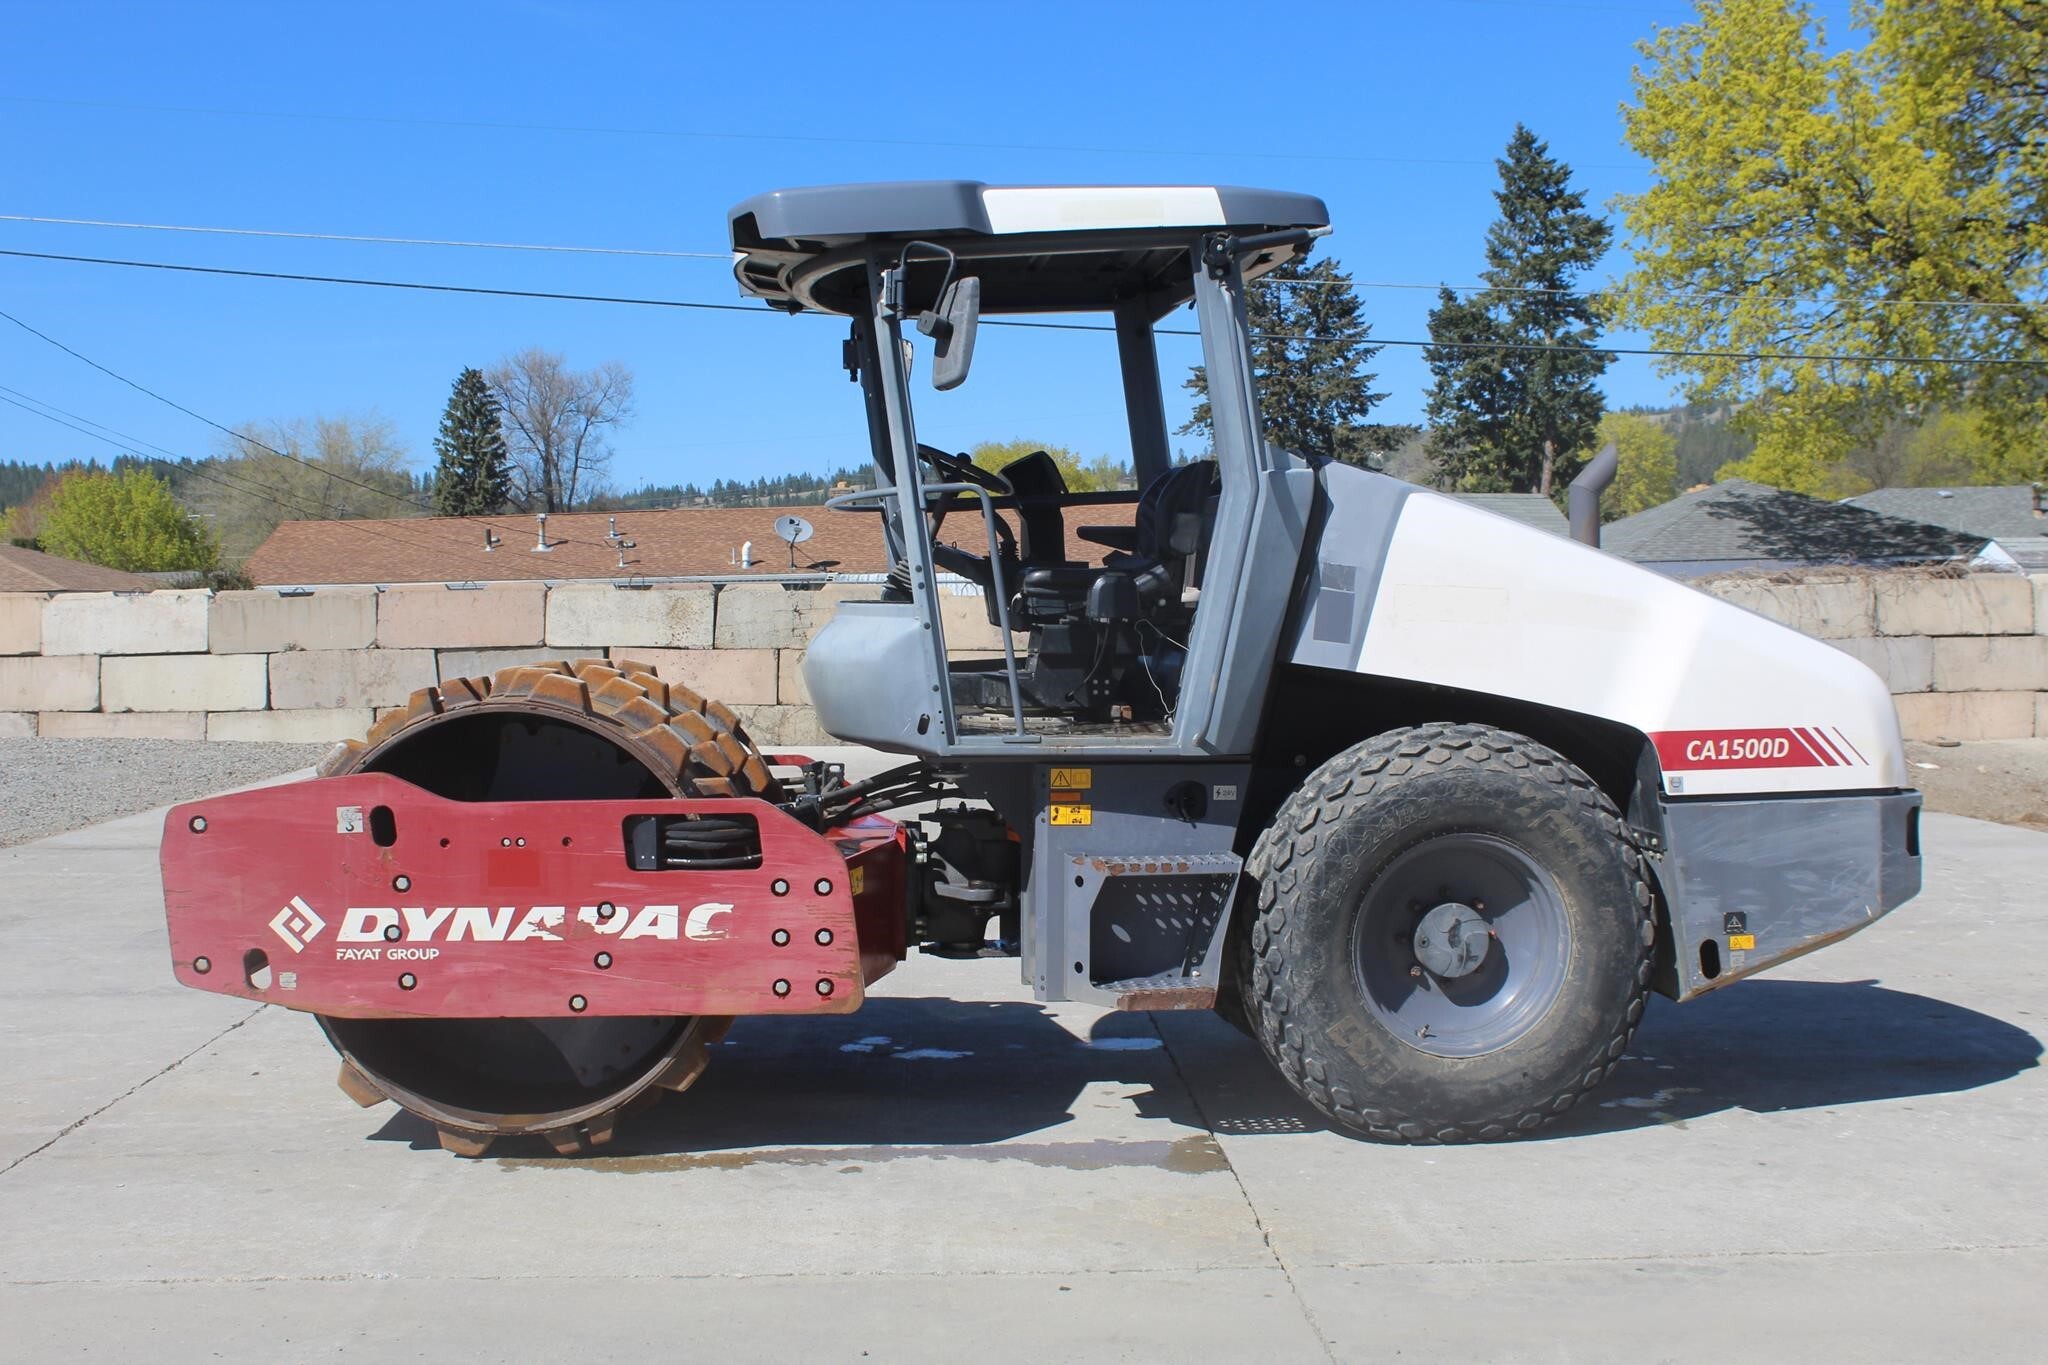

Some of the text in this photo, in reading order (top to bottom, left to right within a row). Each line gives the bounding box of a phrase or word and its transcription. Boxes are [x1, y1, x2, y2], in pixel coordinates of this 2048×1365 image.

[1686, 737, 1790, 761] CA1500D
[336, 902, 735, 942] DYNAPAC
[336, 948, 440, 961] FAYAT GROUP
